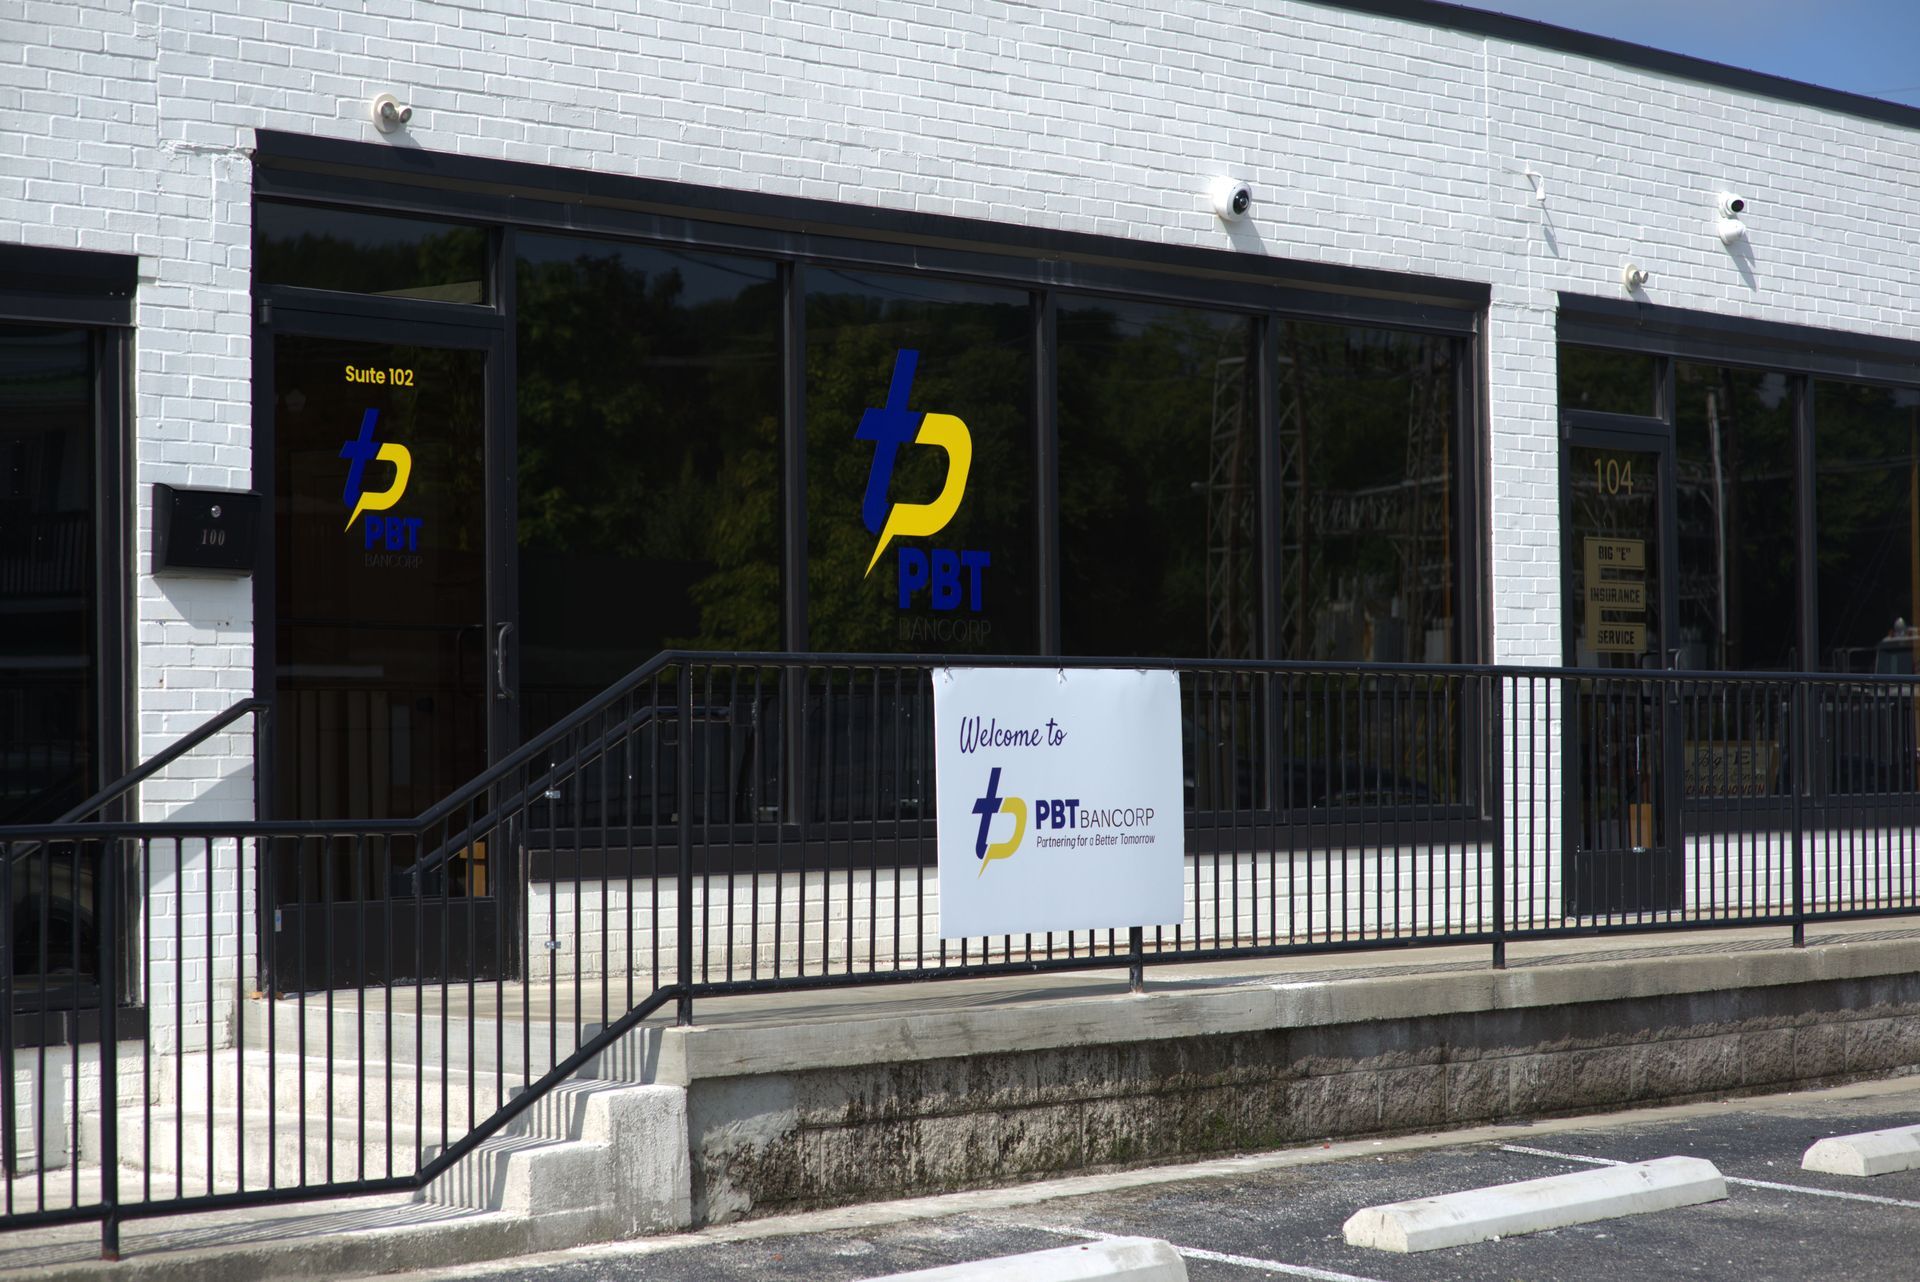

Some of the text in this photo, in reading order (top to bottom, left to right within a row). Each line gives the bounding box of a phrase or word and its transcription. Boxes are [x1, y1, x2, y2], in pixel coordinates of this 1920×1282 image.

[345, 364, 415, 387] Suite 102
[1594, 458, 1634, 495] 104
[201, 530, 226, 547] 100
[365, 515, 424, 552] PBT
[364, 553, 424, 569] BANCORP
[1598, 545, 1614, 561] BIG
[898, 547, 991, 613] PBT
[1590, 587, 1640, 604] INSURANCE
[899, 616, 992, 642] BANCORP
[1598, 630, 1635, 645] SERVICE
[960, 716, 1068, 754] Welcome to
[1035, 799, 1155, 830] PBT BANCORP
[1036, 832, 1156, 850] Partnering for a Better Tomorrow
